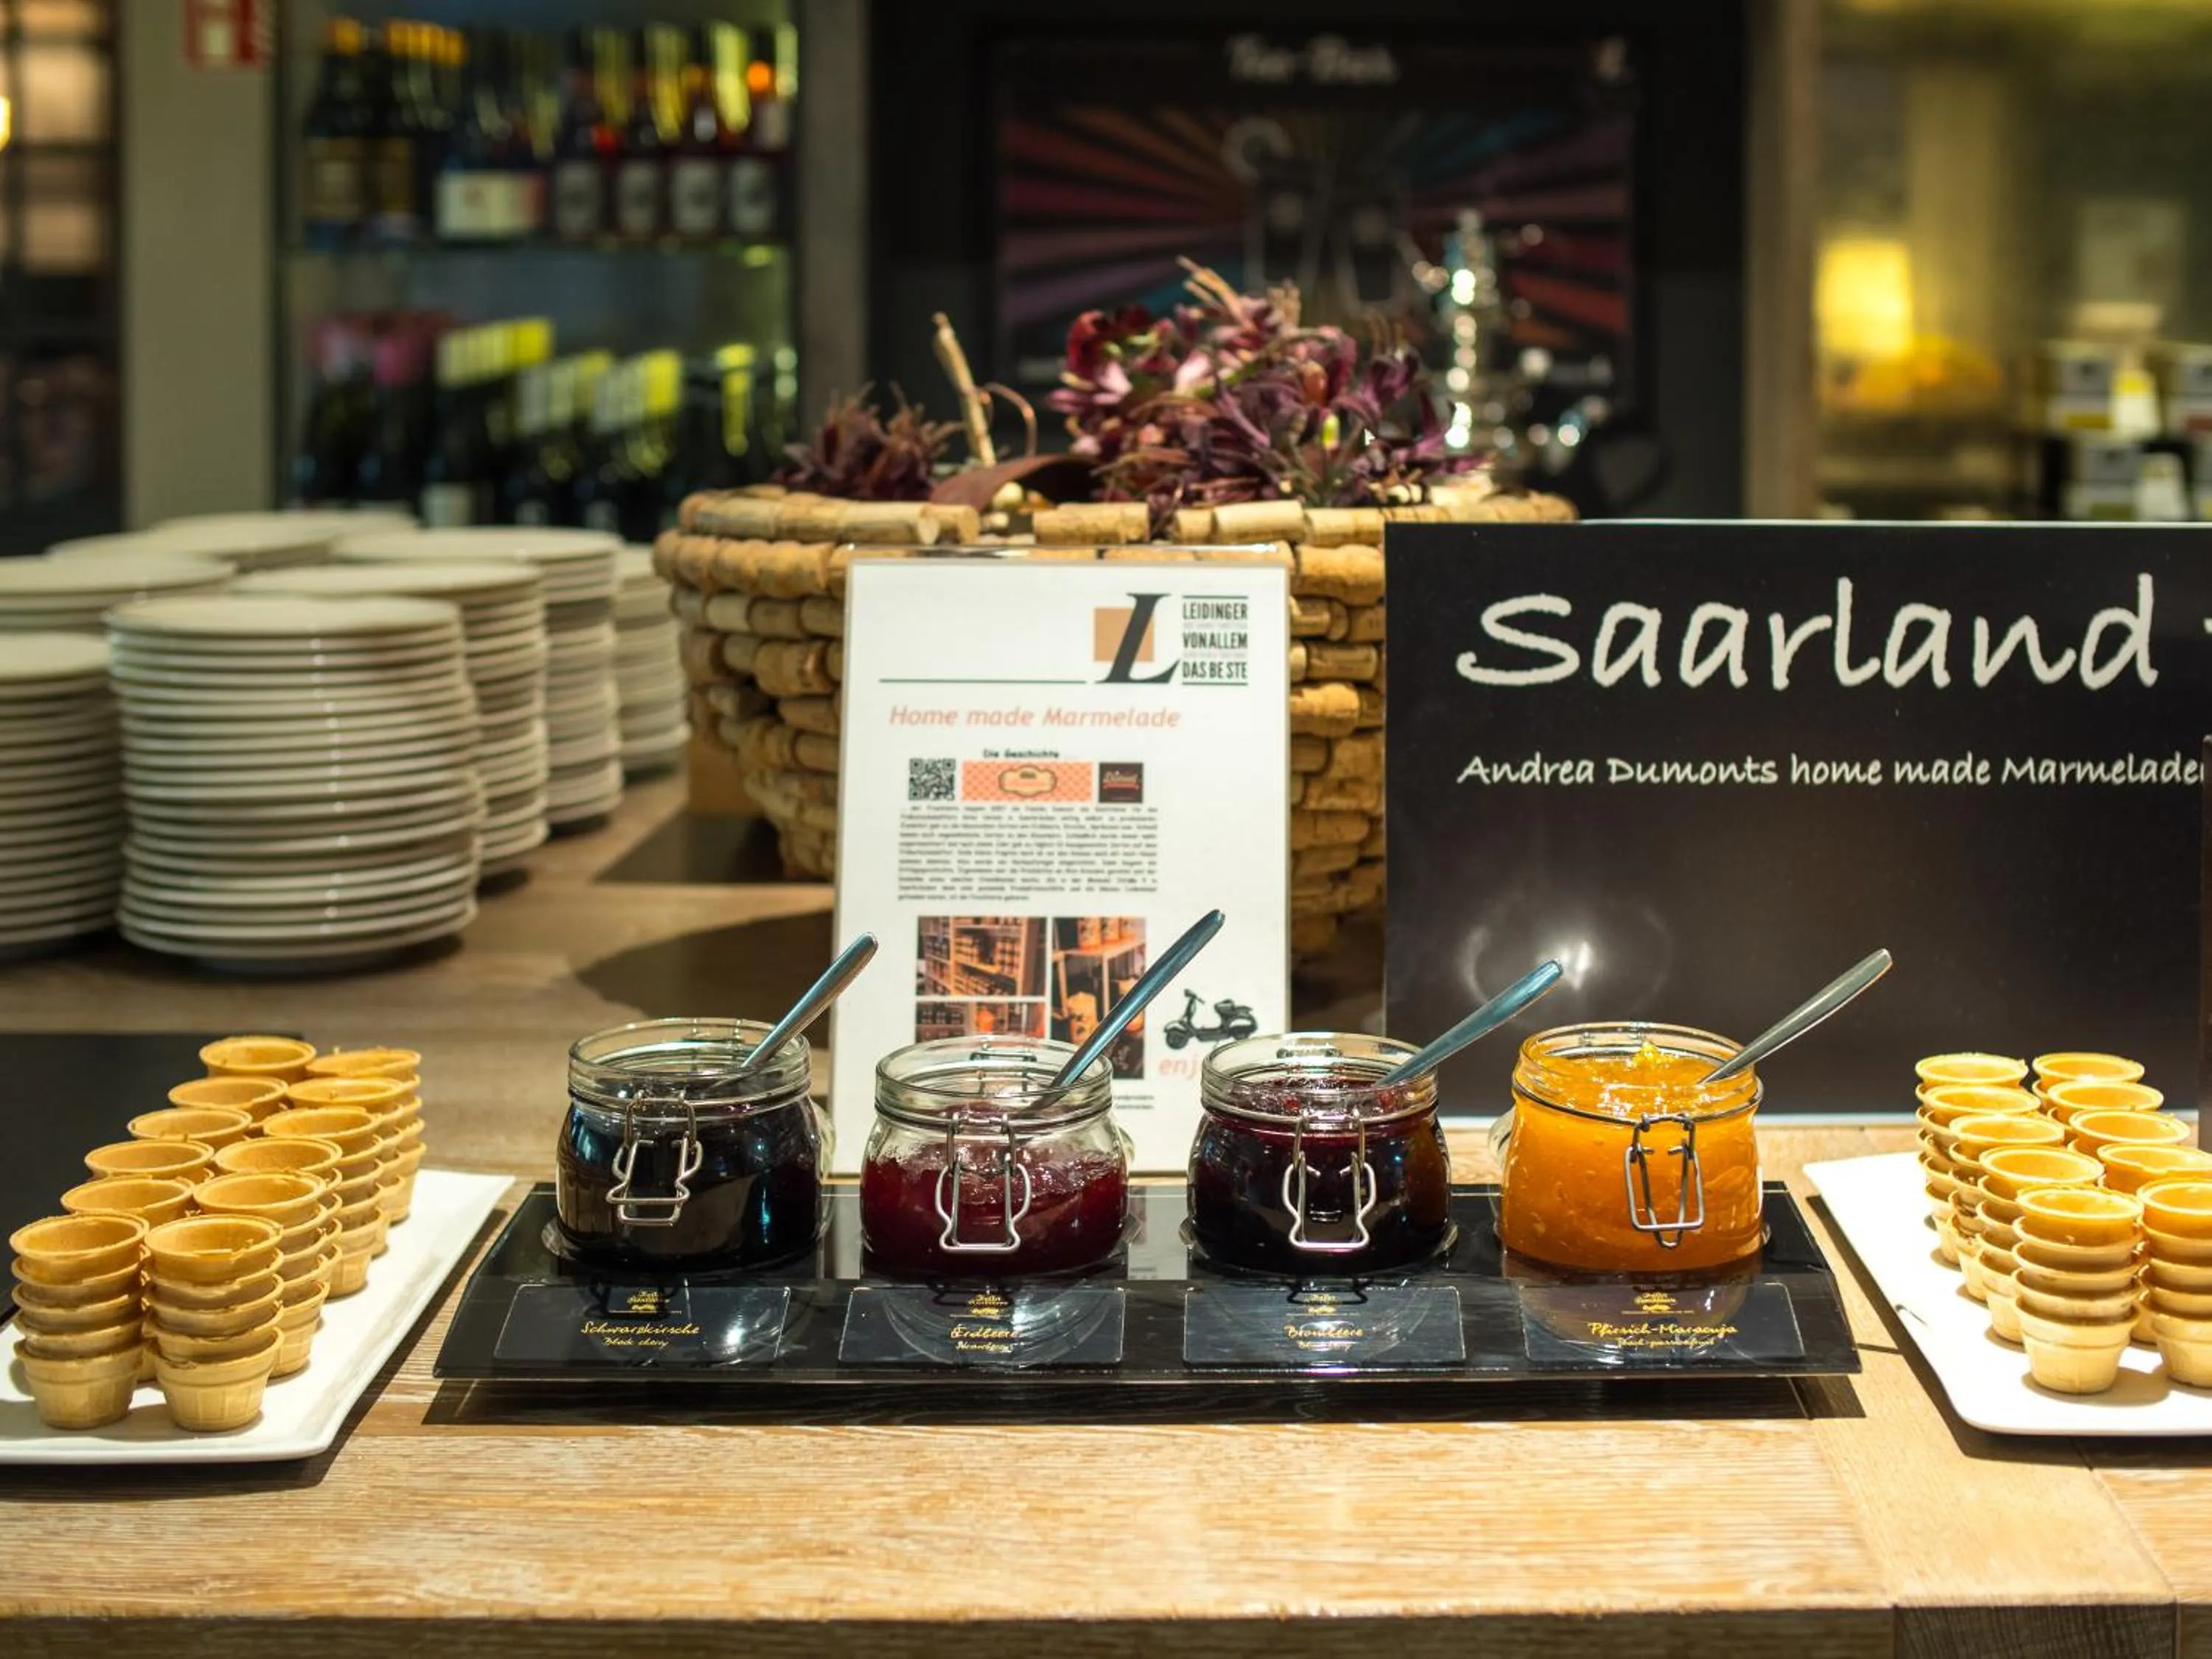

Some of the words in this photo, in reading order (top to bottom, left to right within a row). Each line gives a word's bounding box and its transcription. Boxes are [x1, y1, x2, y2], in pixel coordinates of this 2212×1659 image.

[1182, 602, 1248, 620] LEIDINGER
[1094, 592, 1181, 684] L
[1455, 574, 2159, 689] Saarland
[888, 706, 959, 726] Home
[967, 706, 1035, 727] made
[1042, 708, 1181, 728] Marmelade
[983, 748, 999, 758] Die
[1004, 748, 1060, 759] Geschichte
[1456, 752, 1595, 784] Andrea
[1606, 757, 1779, 785] Dumonts
[1790, 752, 1882, 785] home
[1893, 751, 1991, 785] made
[1158, 1055, 1201, 1079] enj
